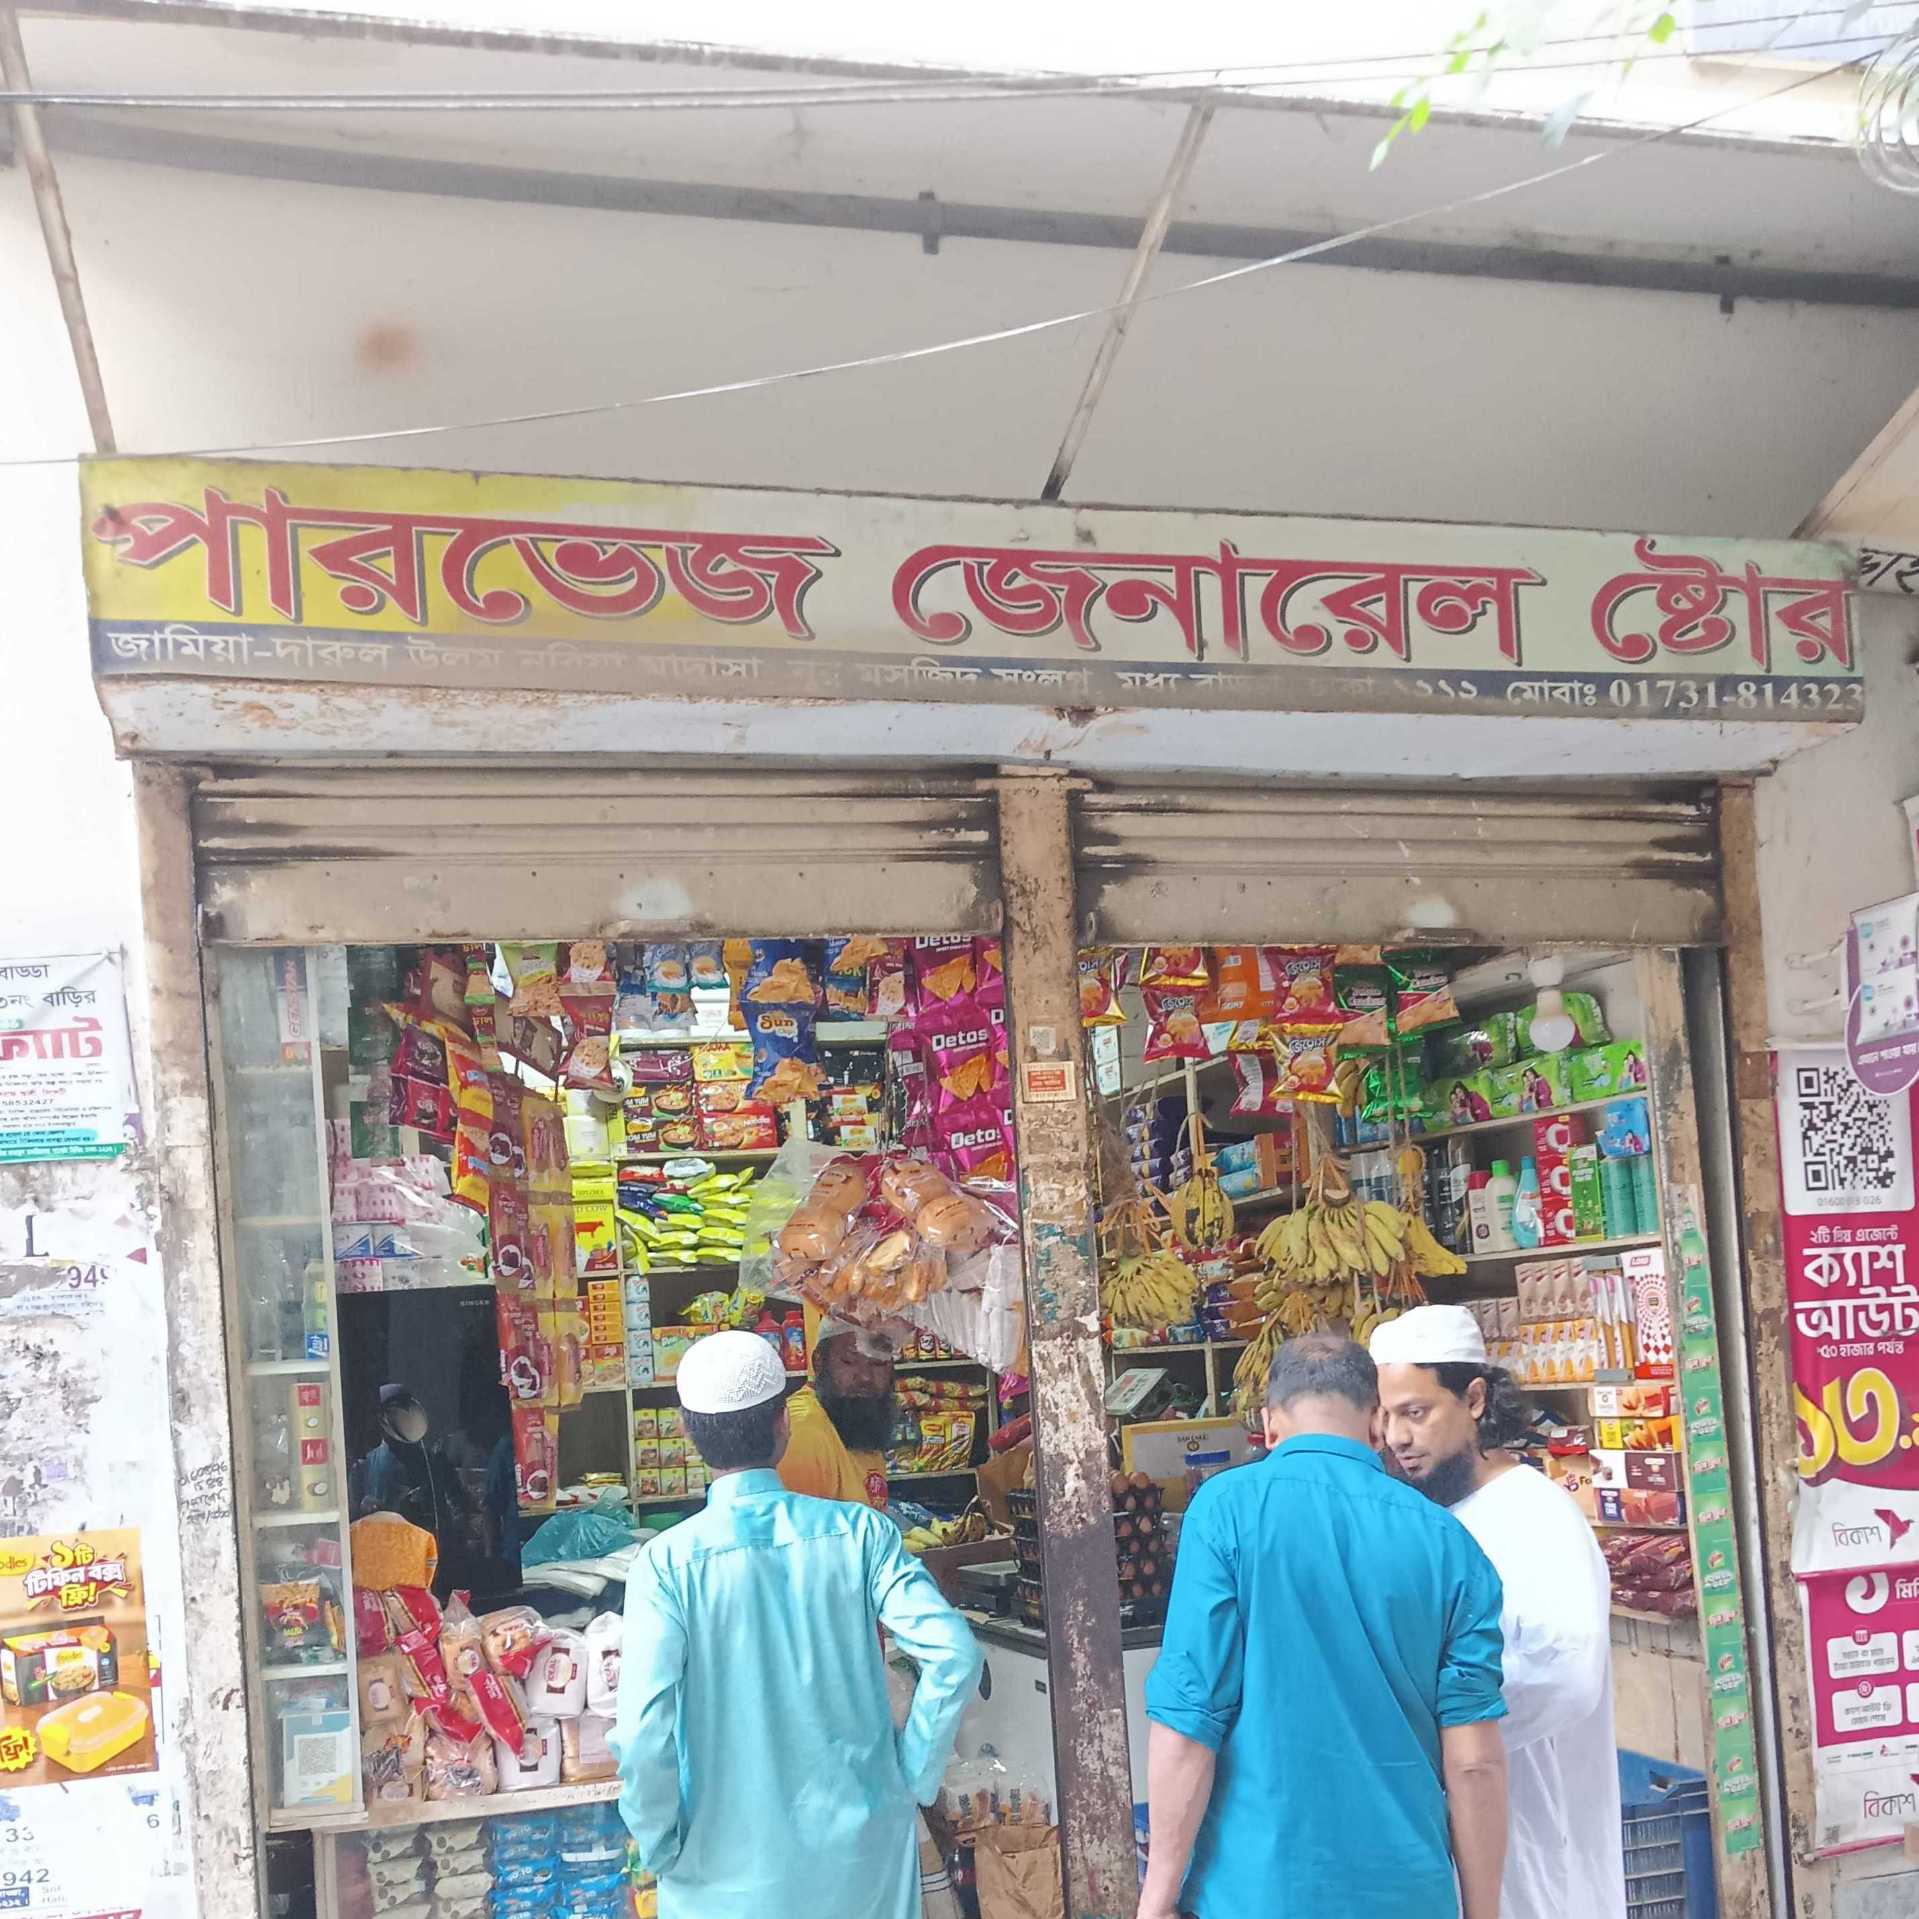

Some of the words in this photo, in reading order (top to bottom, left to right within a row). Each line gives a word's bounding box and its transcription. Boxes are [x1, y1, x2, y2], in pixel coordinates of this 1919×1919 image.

[91, 486, 841, 641] পারভেজ
[892, 538, 1547, 666] জেনারেল
[1591, 536, 1856, 670] ষ্টোর
[1609, 679, 1863, 711] 01731-814323
[42, 986, 96, 1008] বাড়ির
[760, 1016, 795, 1029] Sun
[932, 1029, 989, 1053] Detos
[1803, 1244, 1906, 1288] ক্যাশ
[1793, 1284, 1919, 1340] আউট
[1840, 1343, 1875, 1357] হাজার
[1832, 1523, 1882, 1548] বিকাশ
[51, 1540, 94, 1567] ১টি
[25, 1567, 85, 1596] টিফিন
[1863, 1791, 1917, 1819] বিকাশ
